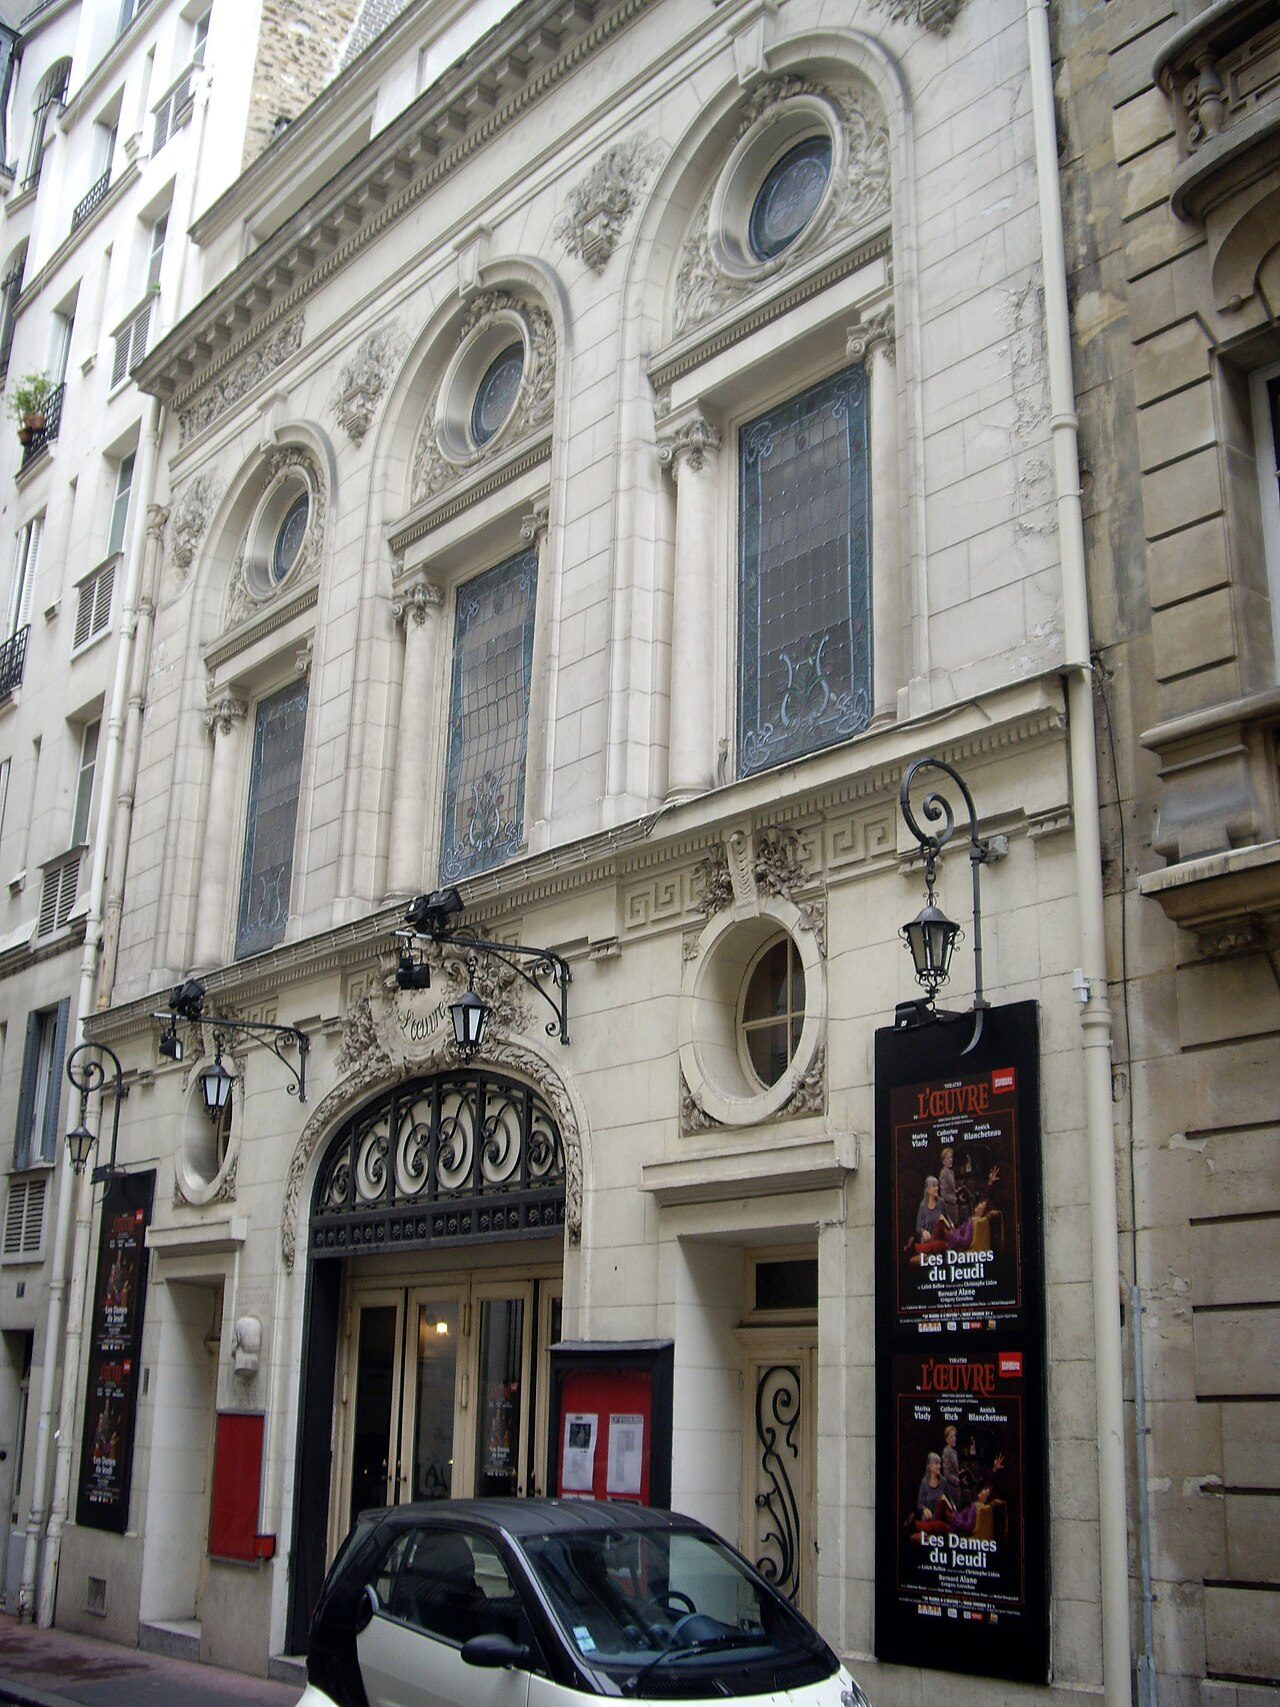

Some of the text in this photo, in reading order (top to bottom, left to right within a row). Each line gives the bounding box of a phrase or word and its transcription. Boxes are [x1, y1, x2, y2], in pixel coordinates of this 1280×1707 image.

[917, 1083, 989, 1119] L'ŒUVRE
[937, 1128, 958, 1137] Catherine
[964, 1129, 1002, 1141] Blancheteau
[912, 1139, 928, 1148] Vlady
[941, 1135, 955, 1144] Rich
[920, 1250, 994, 1267] Les Dames
[928, 1263, 984, 1282] du Jeudi
[921, 1358, 995, 1393] L'ŒUVRE
[940, 1405, 962, 1413] Catherine
[914, 1412, 931, 1421] Vlady
[944, 1413, 958, 1421] Rich
[968, 1413, 1008, 1422] Blancheteau
[920, 1530, 997, 1552] Les Dames
[929, 1547, 987, 1568] du Jeudi
